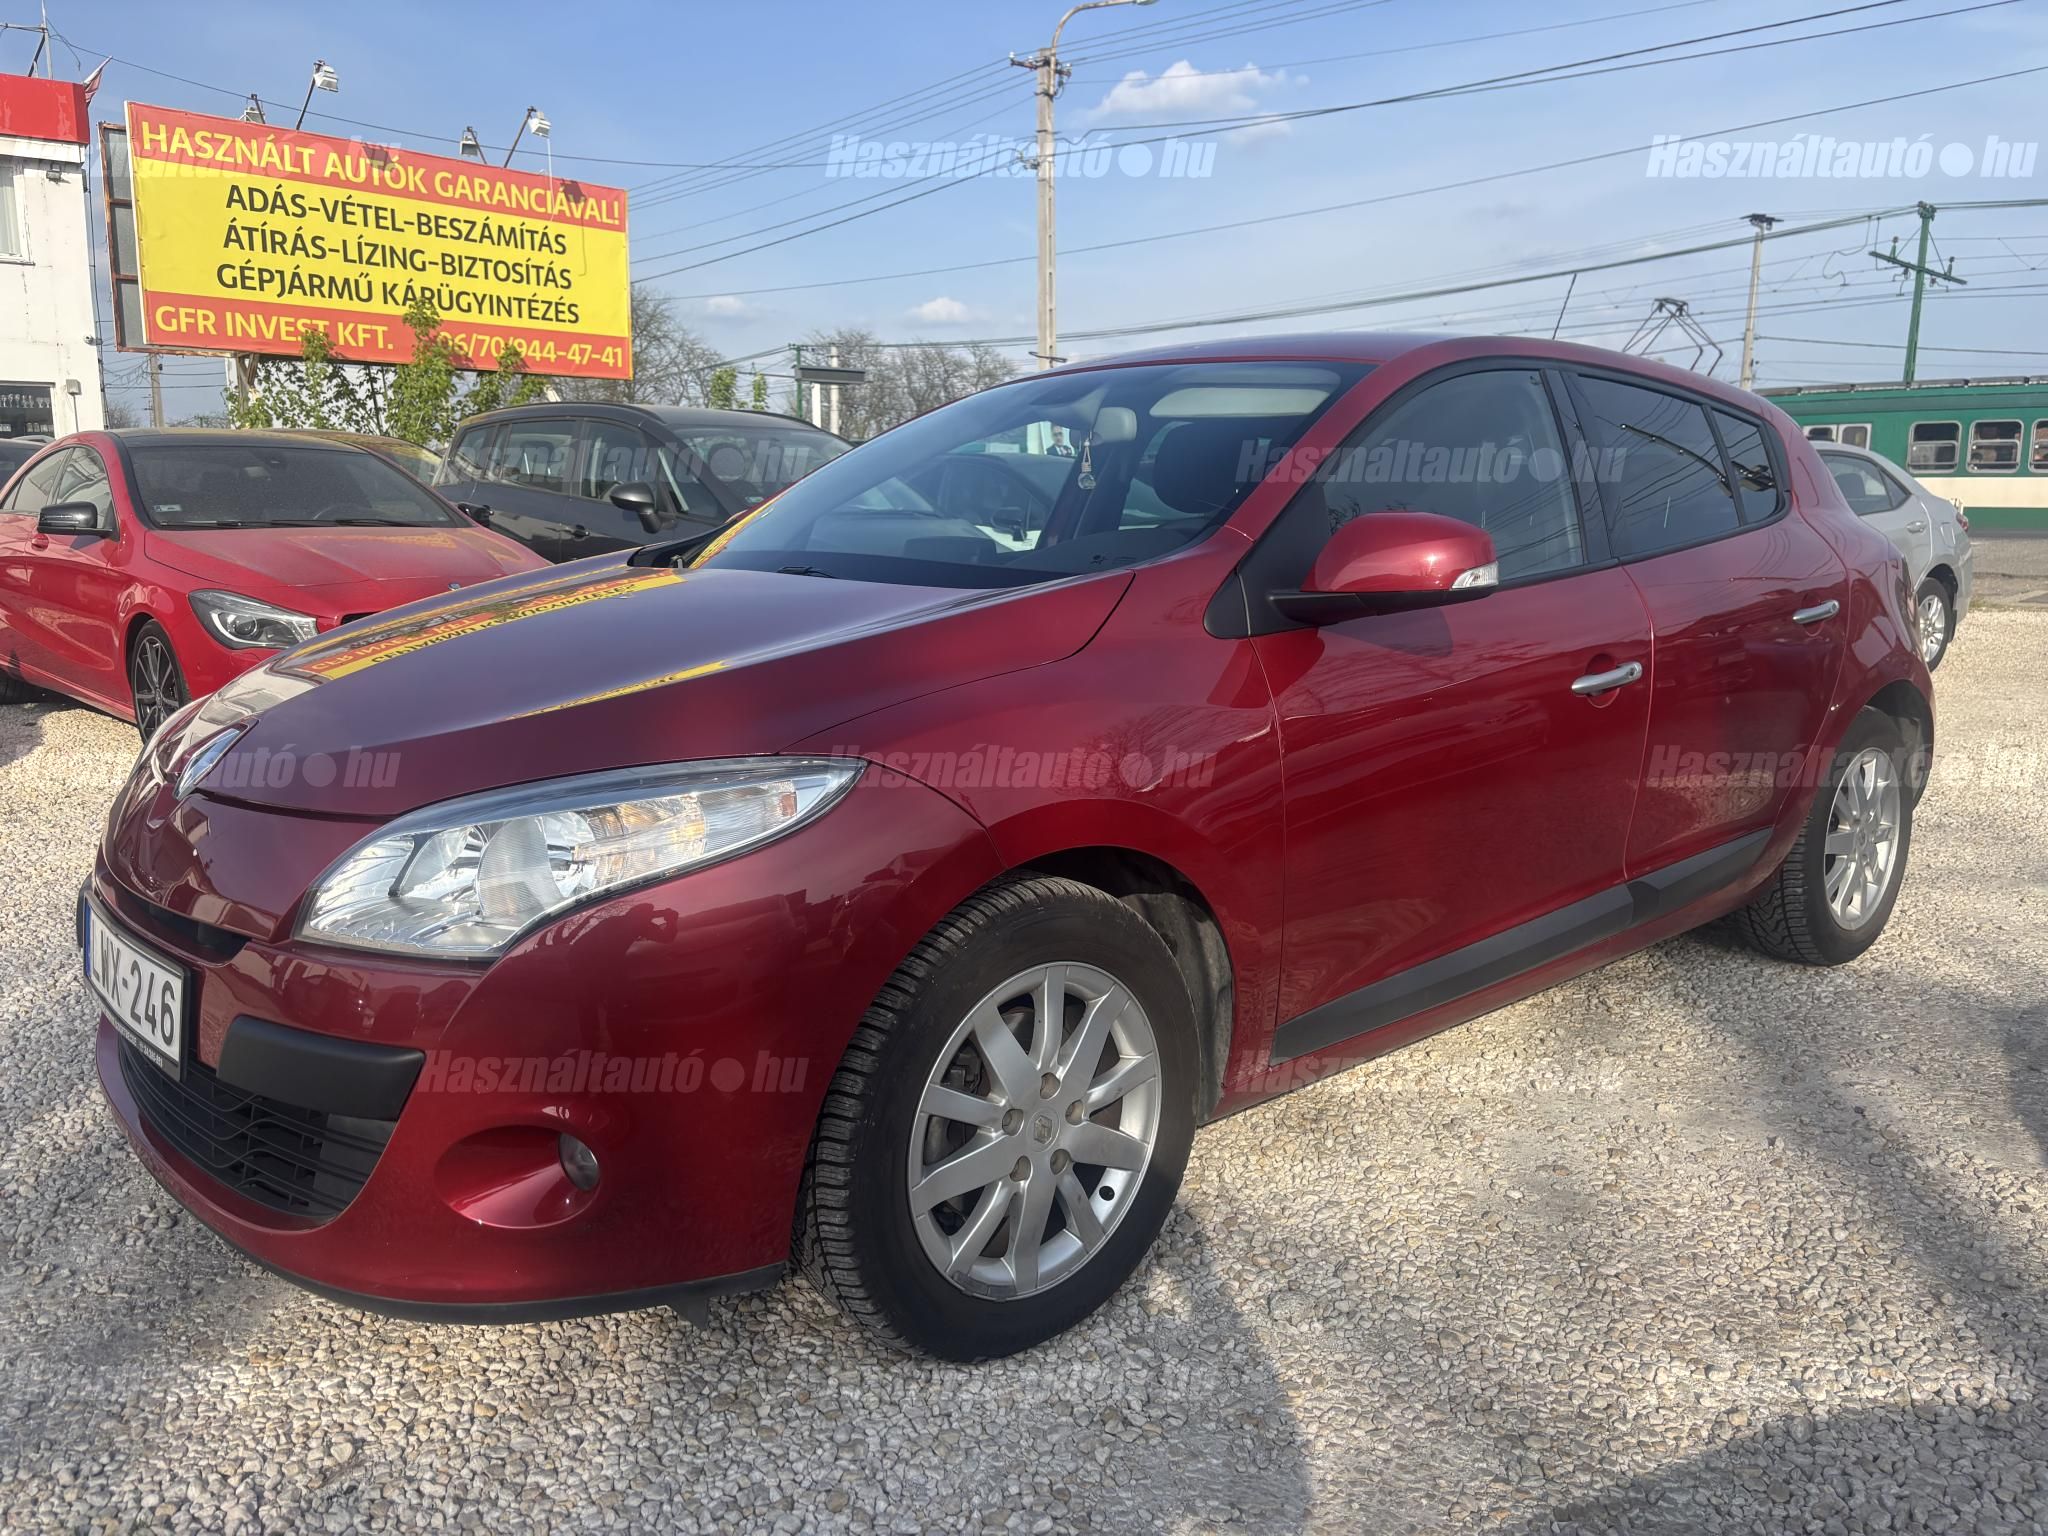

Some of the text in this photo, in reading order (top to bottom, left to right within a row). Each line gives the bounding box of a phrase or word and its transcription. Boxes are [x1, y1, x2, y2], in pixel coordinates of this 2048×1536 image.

[142, 121, 620, 226] HASZNÁLT AUTÓK GARANCIÁVAL!
[223, 217, 572, 290] ÁTÍRÁS-LÍZING-BIZTOSÍTÁS
[226, 183, 567, 256] ADÁS-VÉTEL-BESZÁMÍTÁS
[155, 305, 394, 350] GFR INVEST KFT.
[217, 259, 580, 324] GÉPJÁRMŰ KÁRÜGYINTÉZÉS
[92, 918, 176, 1047] LWX-246
